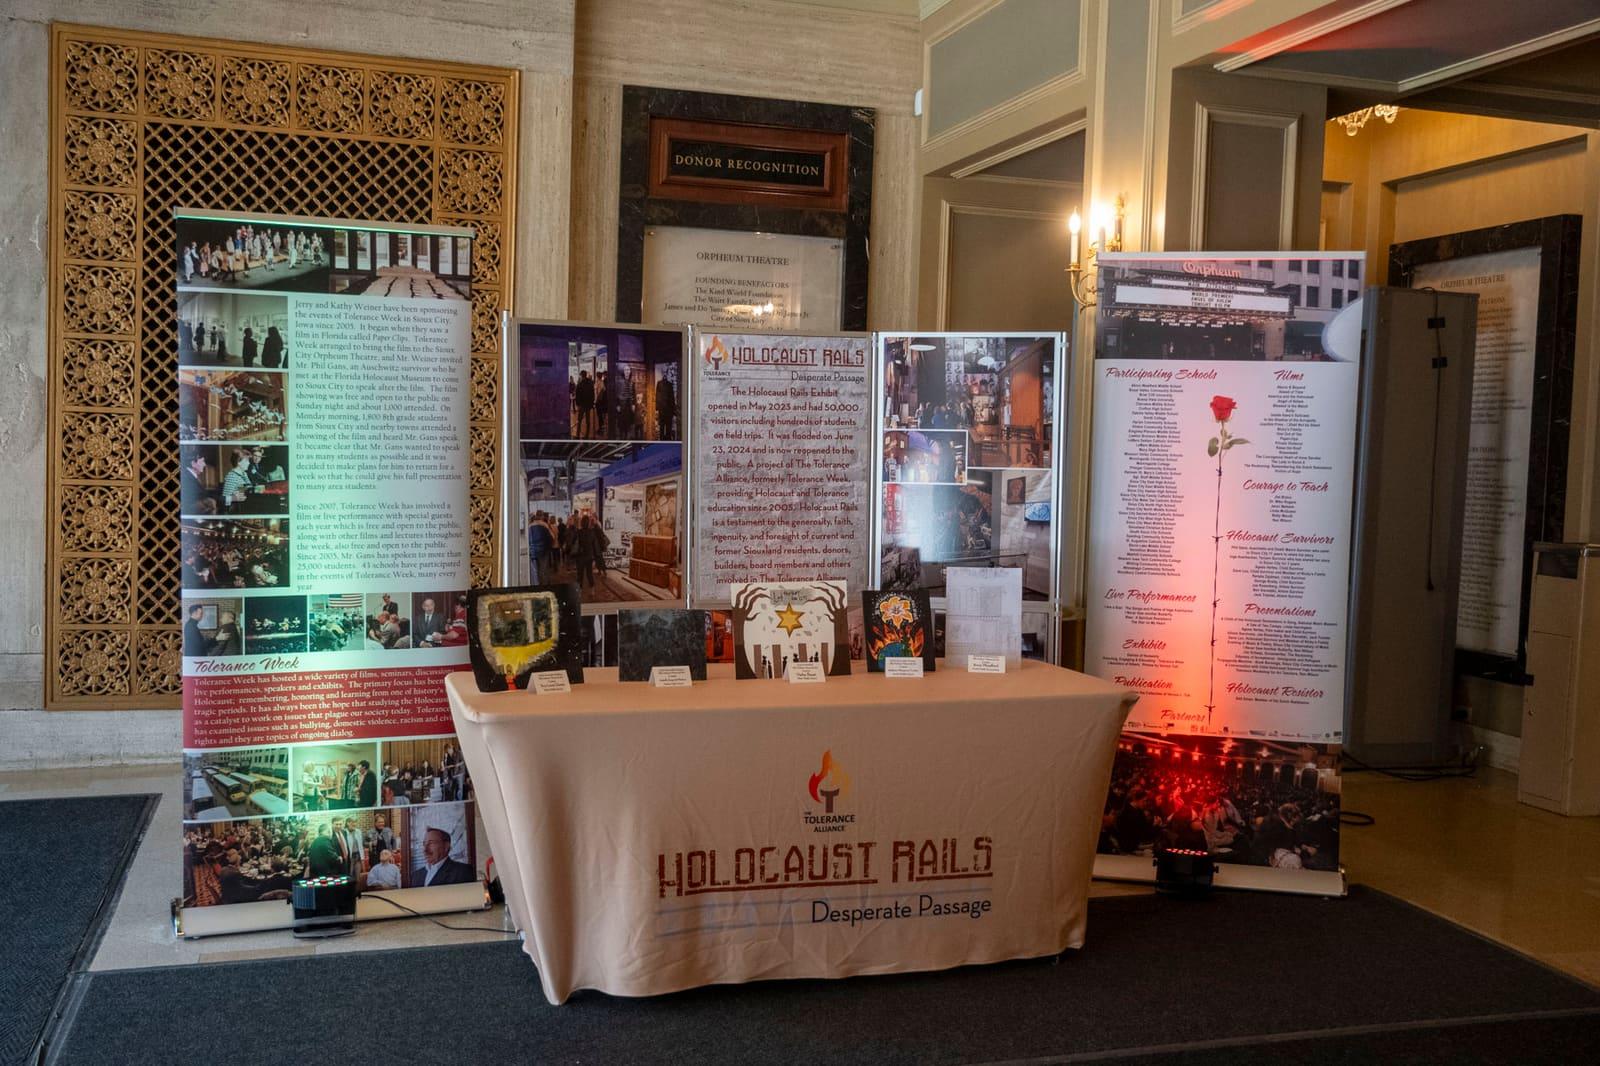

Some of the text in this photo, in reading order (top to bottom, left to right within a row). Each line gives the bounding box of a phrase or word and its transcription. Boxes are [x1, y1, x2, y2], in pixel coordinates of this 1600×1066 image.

[675, 154, 820, 176] DONOR RECOGNITION
[696, 252, 789, 266] ORPHEUM THEATRE
[1183, 261, 1241, 279] Orpheum
[695, 277, 789, 289] FOUNDING BENEFACTORS
[726, 289, 747, 297] World
[296, 300, 313, 310] Jerry
[331, 301, 352, 311] Kathy
[355, 303, 381, 311] Weiner
[384, 304, 400, 312] have
[420, 307, 458, 315] sponsoring
[732, 347, 864, 367] HOLOCAUST RAILS
[791, 370, 864, 384] Desperate Passage
[1105, 367, 1217, 382] Participating Schools
[1273, 370, 1304, 381] Films
[731, 386, 838, 397] The Holocaust Rails Exhibit
[708, 402, 737, 412] opened
[739, 402, 747, 410] in
[749, 402, 766, 412] May
[768, 403, 791, 411] 2023
[793, 402, 806, 411] and
[809, 402, 822, 411] had
[710, 416, 739, 425] visitors
[740, 417, 775, 427] including
[777, 417, 813, 426] hundreds
[824, 418, 856, 426] students
[725, 431, 742, 439] field
[744, 432, 764, 441] trips.
[769, 432, 774, 440] It
[792, 431, 822, 440] flooded
[834, 432, 853, 440] June
[712, 446, 725, 454] 23,
[728, 446, 750, 454] 2024
[752, 445, 766, 454] and
[768, 446, 774, 454] is
[794, 446, 830, 455] reopened
[832, 446, 840, 454] to
[842, 446, 854, 454] the
[756, 461, 784, 470] project
[795, 460, 811, 468] The
[813, 461, 850, 469] Tolerance
[715, 474, 750, 484] Alliance,
[752, 475, 785, 484] formerly
[787, 474, 824, 483] Tolerance
[1243, 479, 1329, 493] Courage to Teach
[717, 488, 848, 498] providing Holocaust and Tolerance
[708, 502, 746, 513] education
[748, 504, 767, 512] since
[800, 503, 838, 511] Holocaust
[840, 502, 858, 511] Rails
[727, 518, 765, 526] testament
[768, 518, 776, 526] to
[777, 518, 790, 526] the
[750, 532, 764, 540] and
[766, 532, 799, 541] foresight
[801, 531, 809, 540] of
[811, 532, 838, 540] current
[841, 531, 854, 540] and
[1226, 530, 1335, 545] Holocaust Survivors
[714, 546, 742, 555] former
[743, 546, 781, 555] Siouxland
[750, 560, 772, 569] board
[774, 561, 810, 569] members
[811, 560, 825, 568] and
[827, 559, 851, 567] others
[716, 574, 748, 583] involved
[750, 575, 757, 583] in
[760, 574, 775, 583] The
[778, 574, 813, 582] Tolerance
[1104, 588, 1196, 604] Live Performances
[1244, 603, 1316, 617] Presentations
[1122, 639, 1166, 650] Exhibits
[193, 656, 300, 673] Tolerance Week
[194, 678, 232, 686] Tolerance
[257, 675, 270, 683] has
[272, 673, 296, 682] hosted
[323, 672, 348, 681] variety
[350, 670, 358, 678] of
[1114, 675, 1173, 689] Publication
[1226, 682, 1324, 698] Holocaust Resistor
[1160, 709, 1206, 722] Partners
[194, 737, 217, 748] rights
[235, 735, 250, 744] they
[266, 733, 289, 743] topics
[291, 731, 298, 739] of
[299, 730, 329, 741] ongoing
[331, 728, 354, 737] dialog.
[804, 814, 856, 824] TOLERANCE
[657, 836, 994, 899] HOLOCAUST RAILS
[811, 893, 992, 928] Desperate Passage
